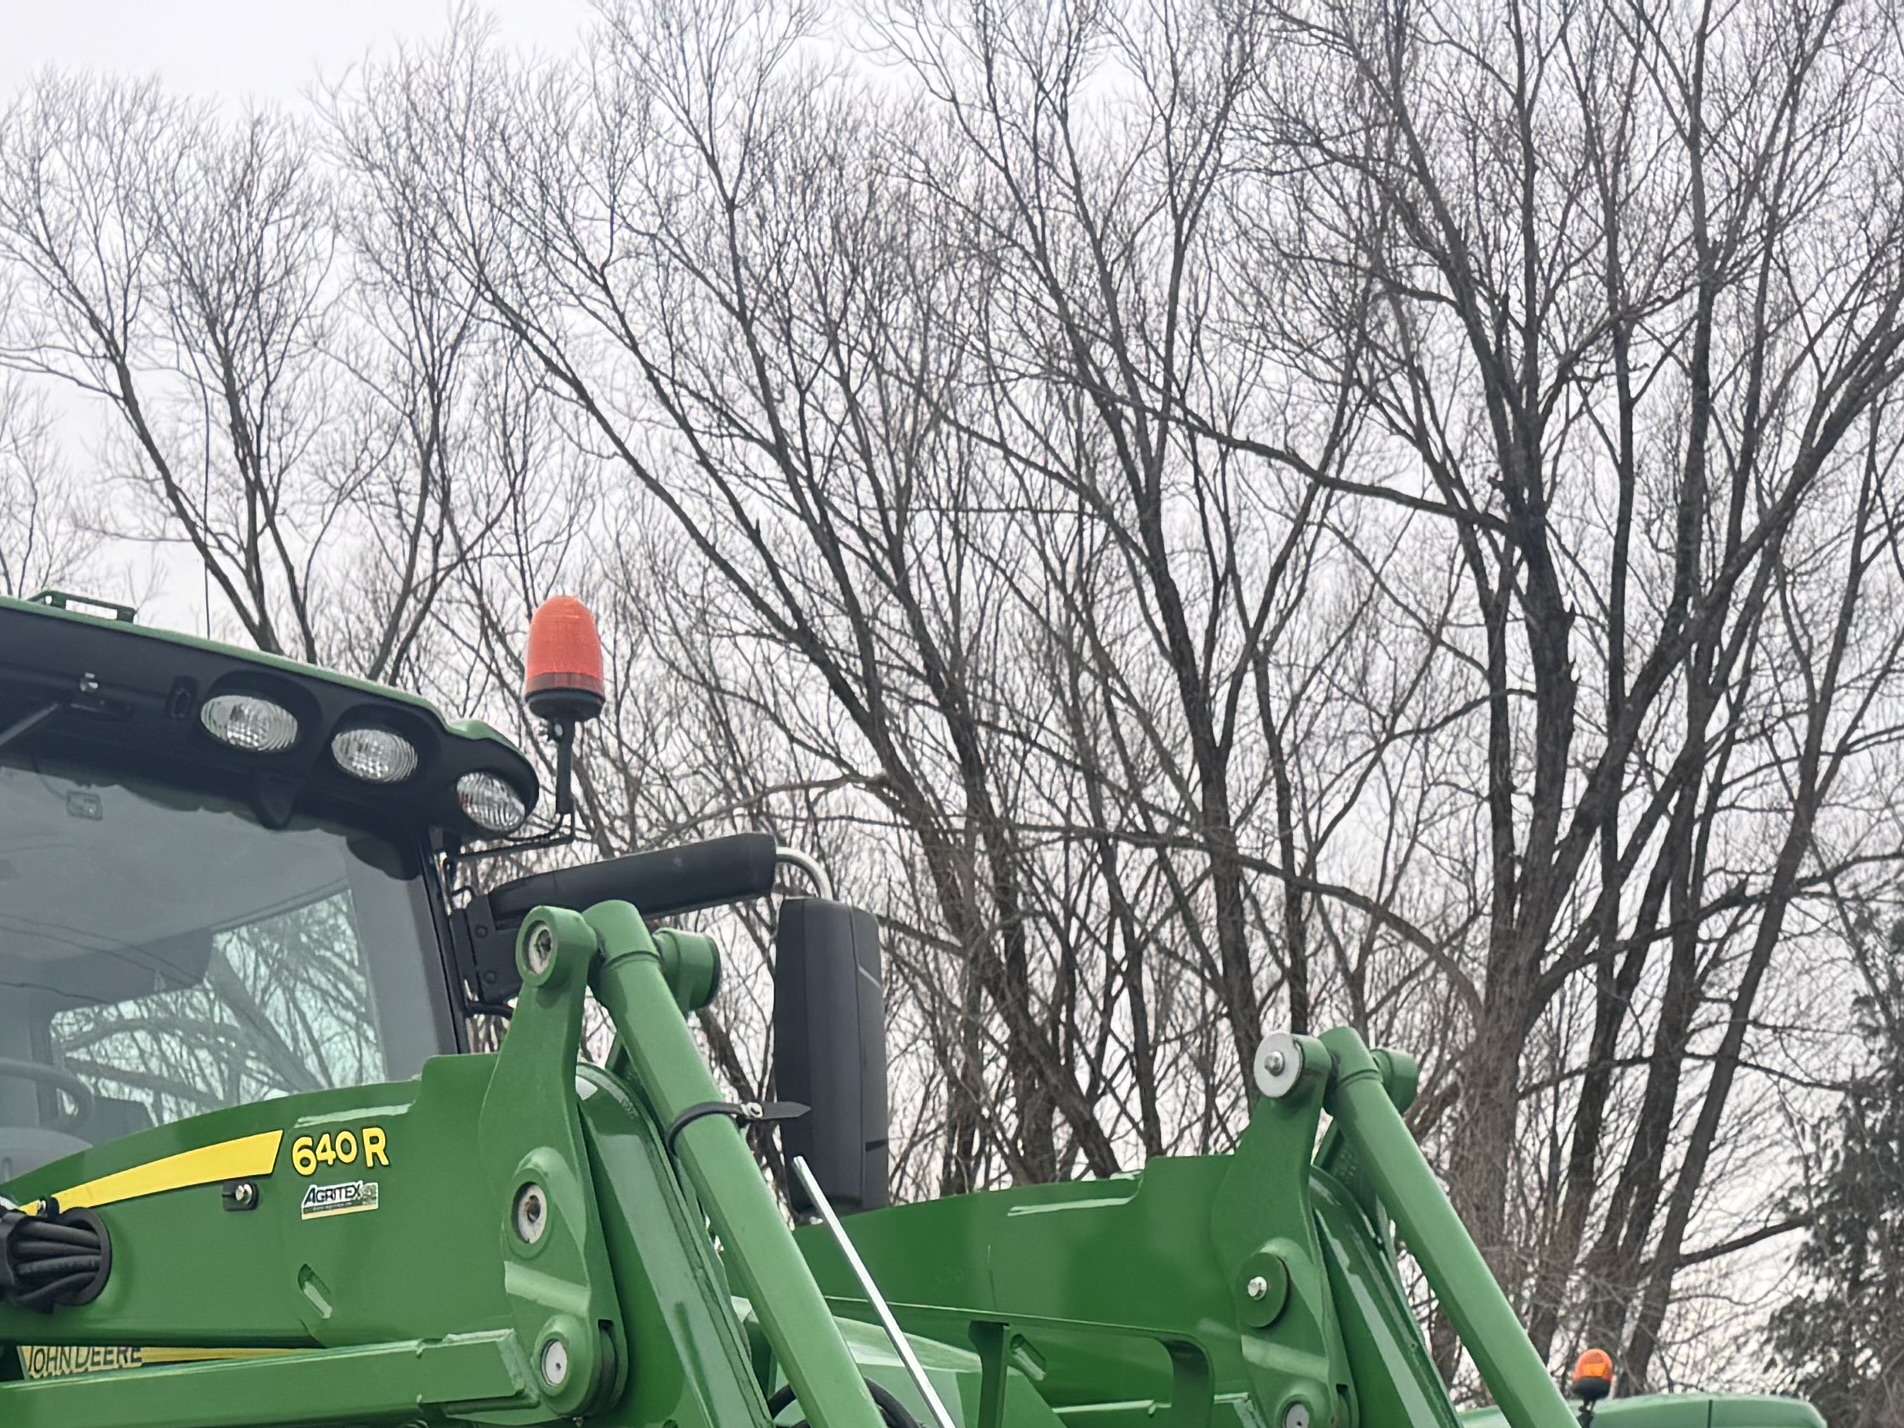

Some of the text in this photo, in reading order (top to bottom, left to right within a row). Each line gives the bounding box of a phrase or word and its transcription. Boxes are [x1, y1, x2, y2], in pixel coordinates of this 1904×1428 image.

[303, 1183, 363, 1206] AGRITEX
[27, 1345, 143, 1374] JOHN DEERE
